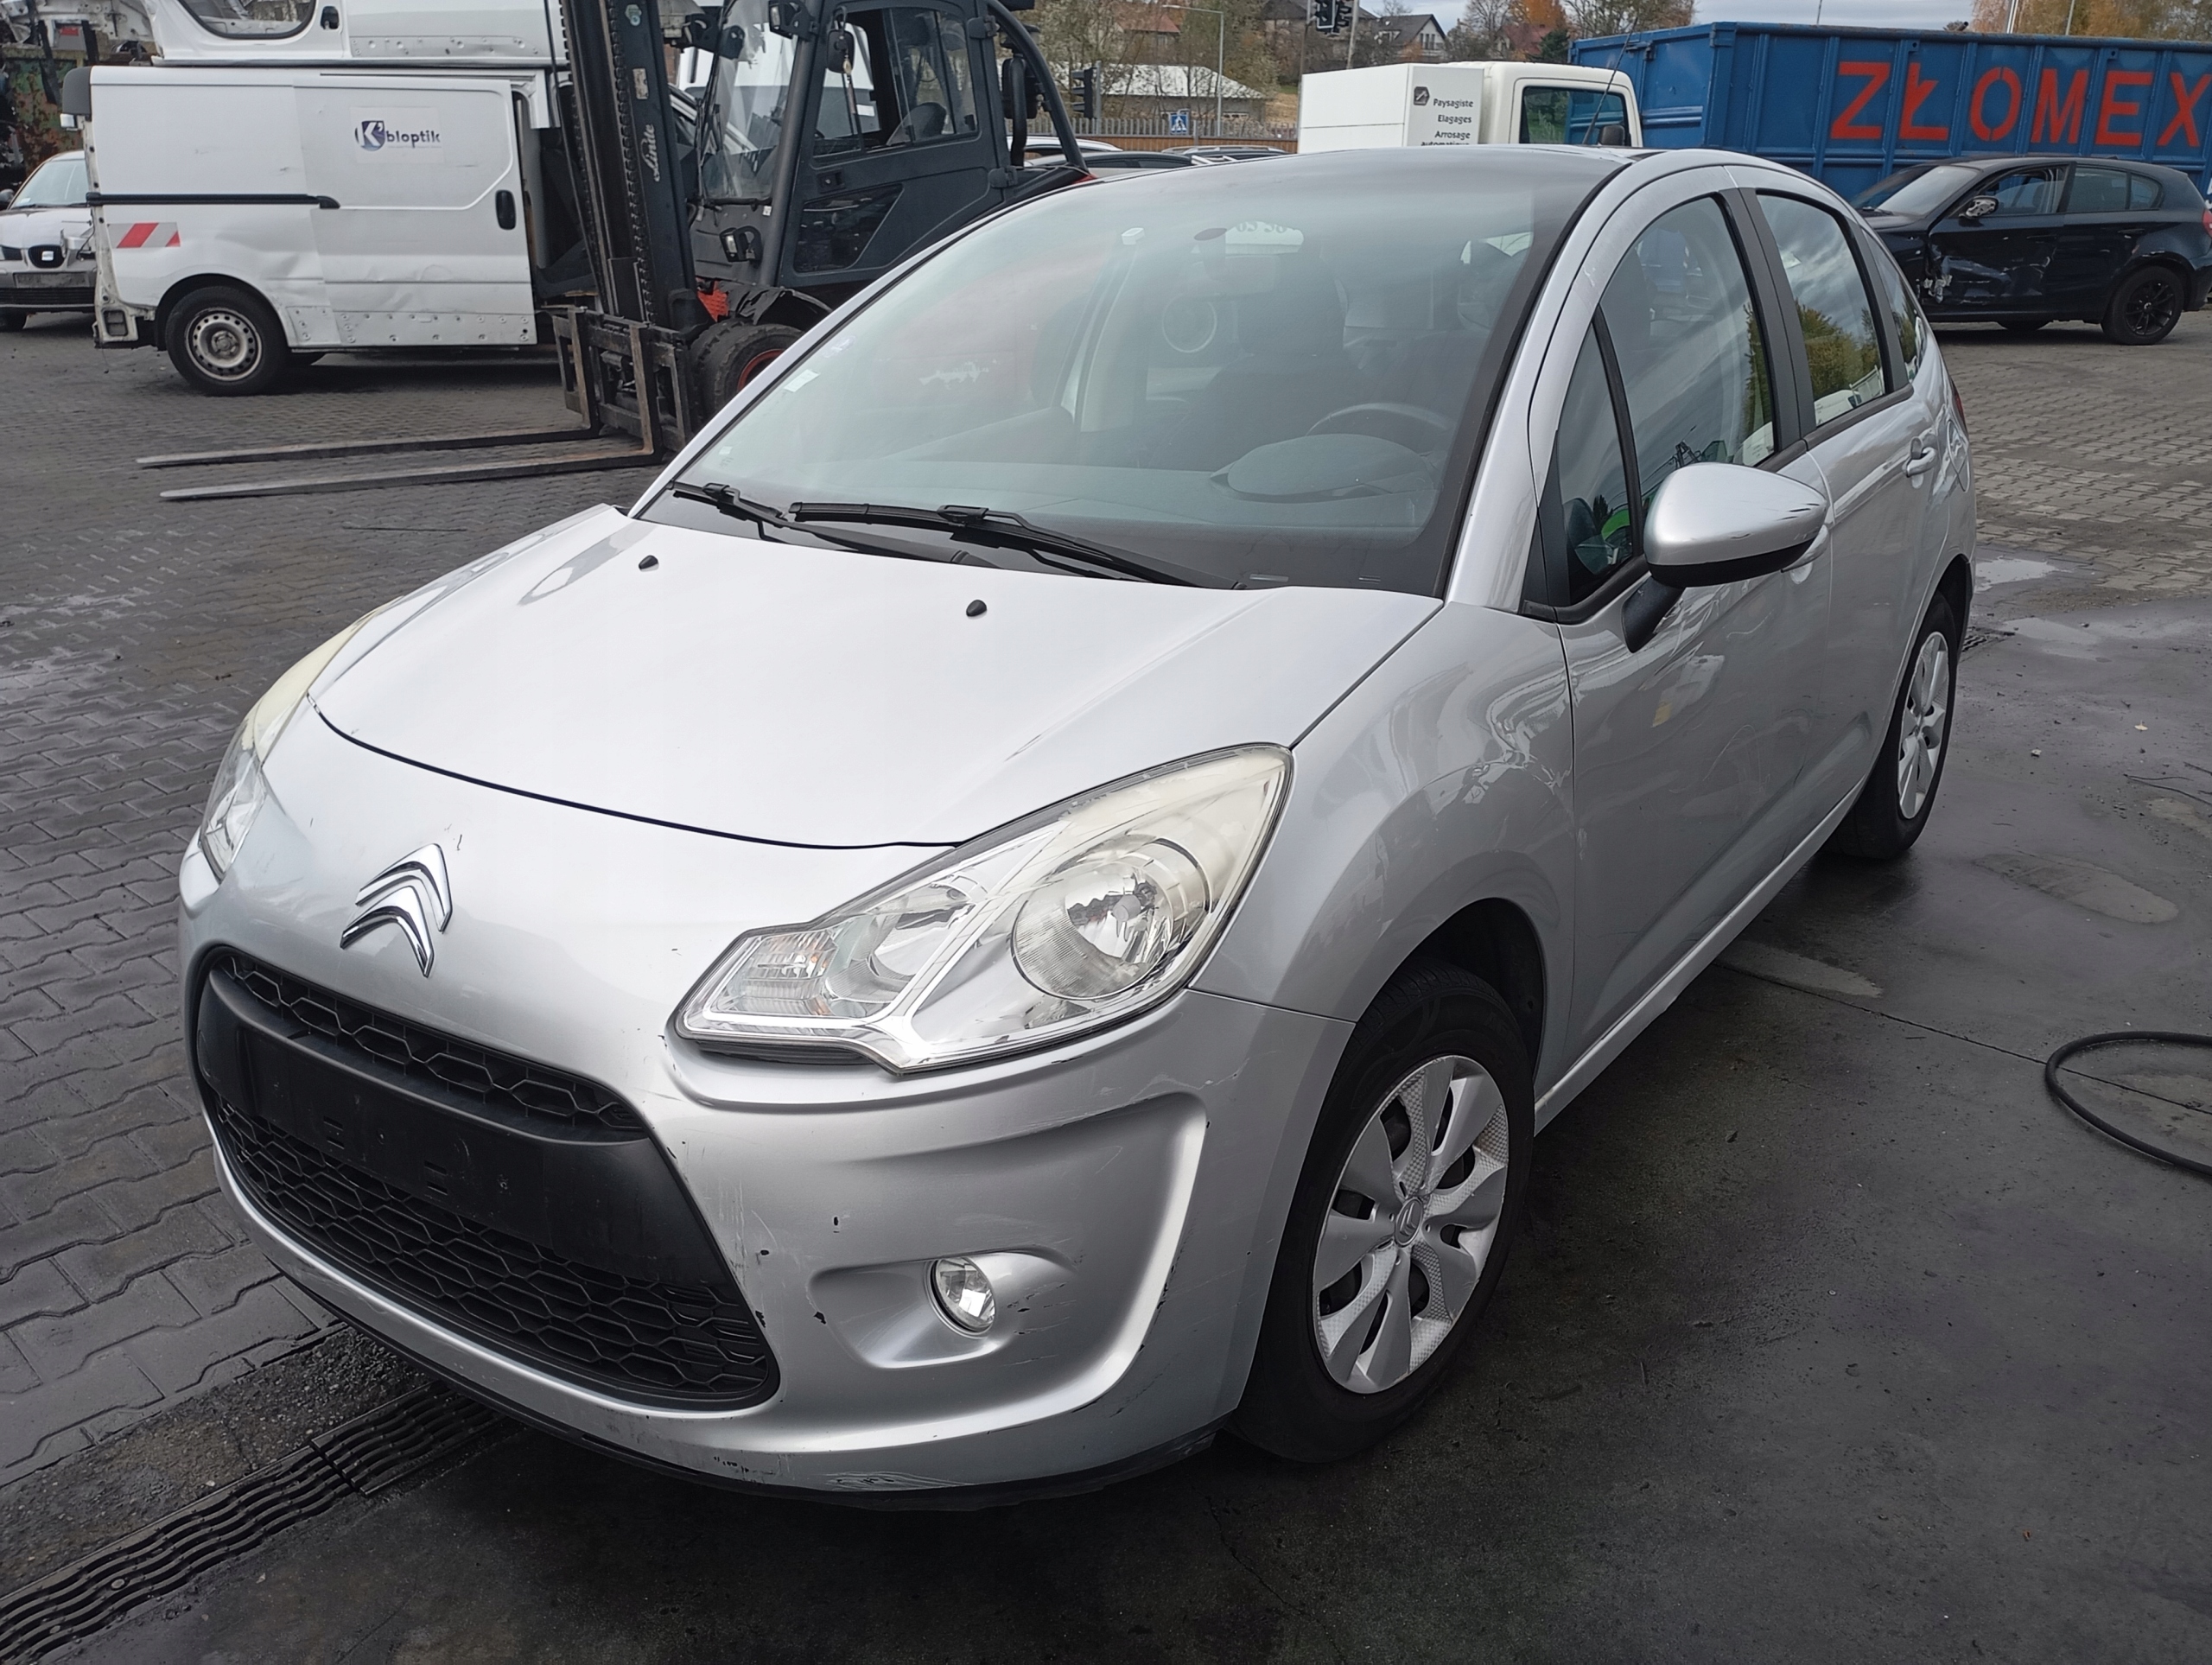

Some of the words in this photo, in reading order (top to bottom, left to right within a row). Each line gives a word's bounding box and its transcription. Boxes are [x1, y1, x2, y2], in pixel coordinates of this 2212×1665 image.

[1433, 98, 1474, 109] Paysagiste
[1830, 61, 2212, 148] ZŁOMEX
[1437, 114, 1472, 124] Elagages
[1434, 130, 1471, 141] Arrosage
[641, 124, 660, 182] Linde
